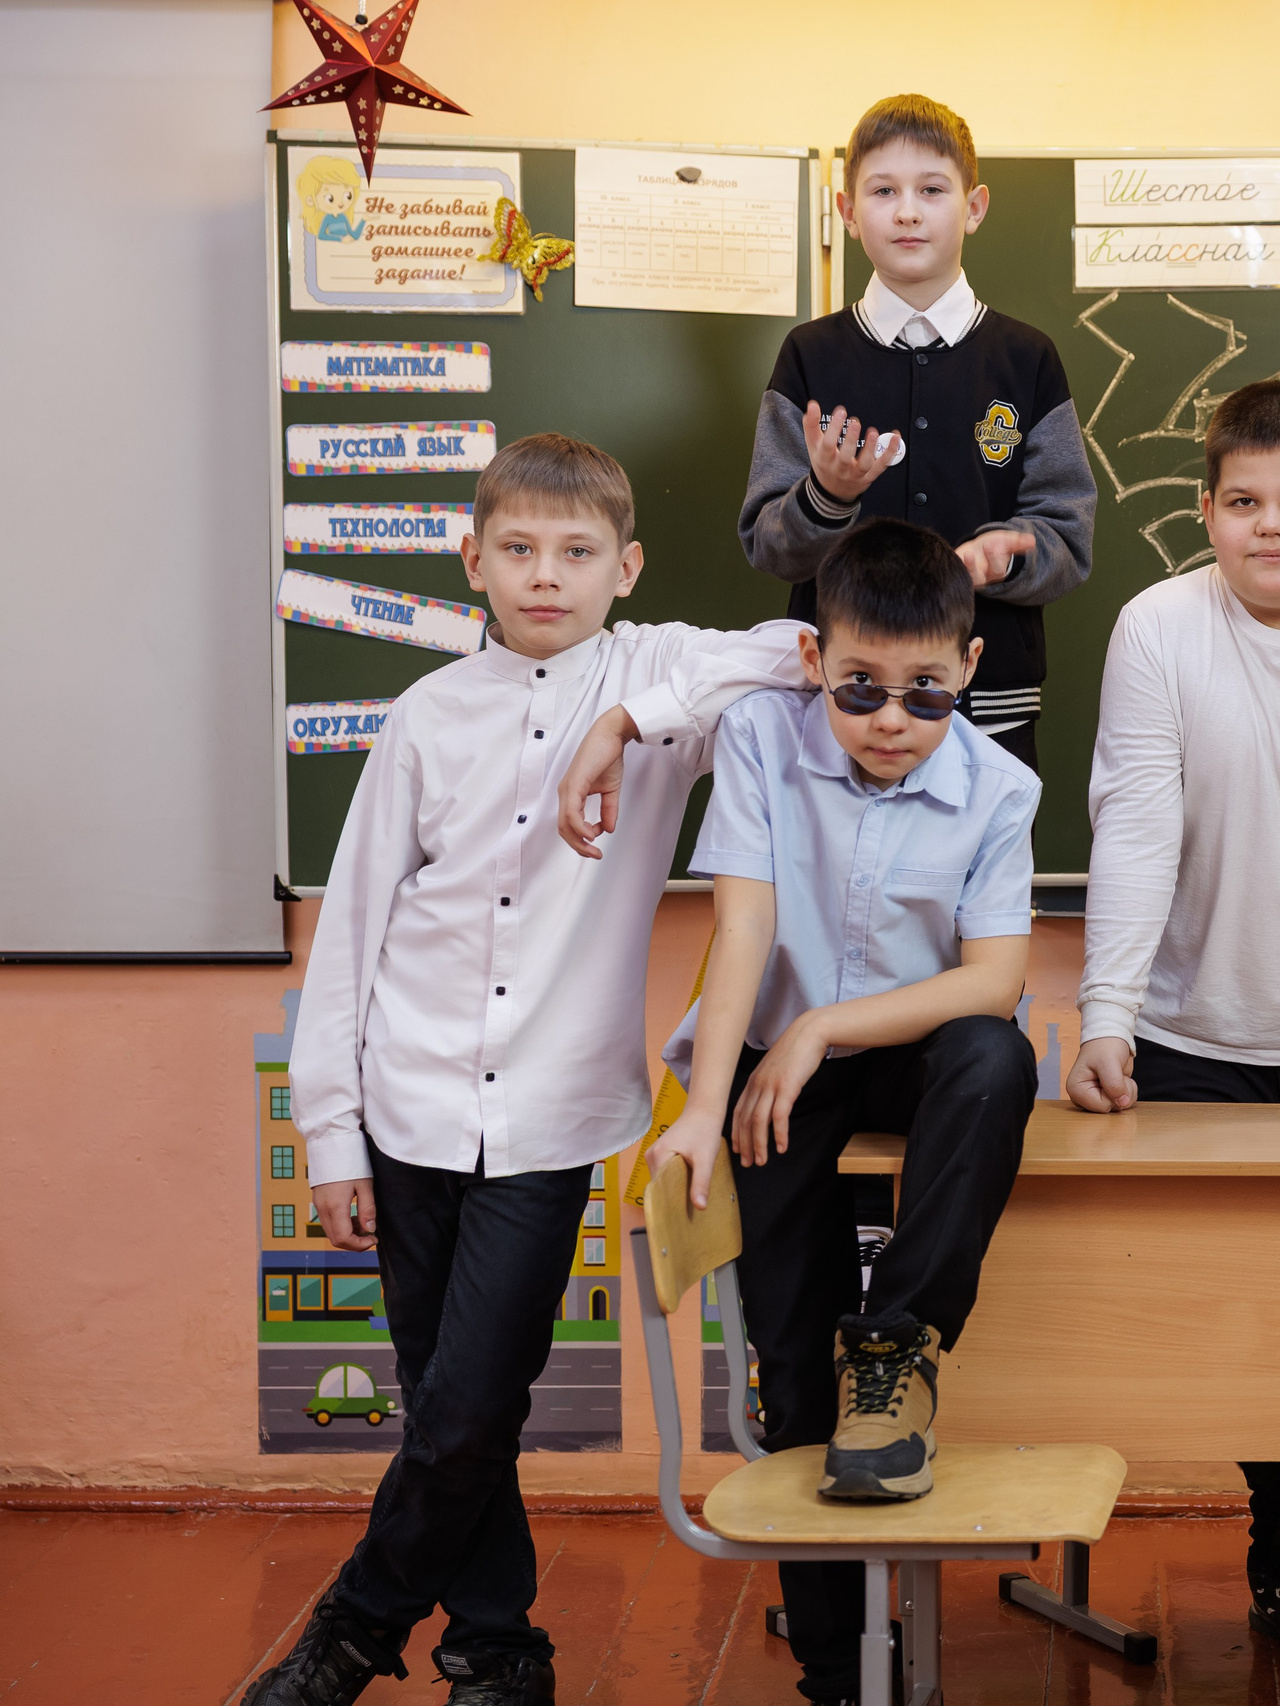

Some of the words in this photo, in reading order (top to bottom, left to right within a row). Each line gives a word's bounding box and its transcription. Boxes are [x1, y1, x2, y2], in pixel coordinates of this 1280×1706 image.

[364, 197, 395, 214] Не
[399, 198, 489, 220] забывай
[365, 221, 493, 241] записывать
[371, 245, 475, 262] домашнее
[374, 264, 466, 285] задание!
[327, 356, 446, 376] МАТЕМАТИКА
[974, 420, 1022, 443] College
[319, 433, 406, 458] РУССКИЙ
[417, 436, 465, 457] ЯЗЫК
[328, 518, 446, 537] ТЕХНОЛОГИЯ
[351, 594, 415, 626] ЧТЕНИЕ
